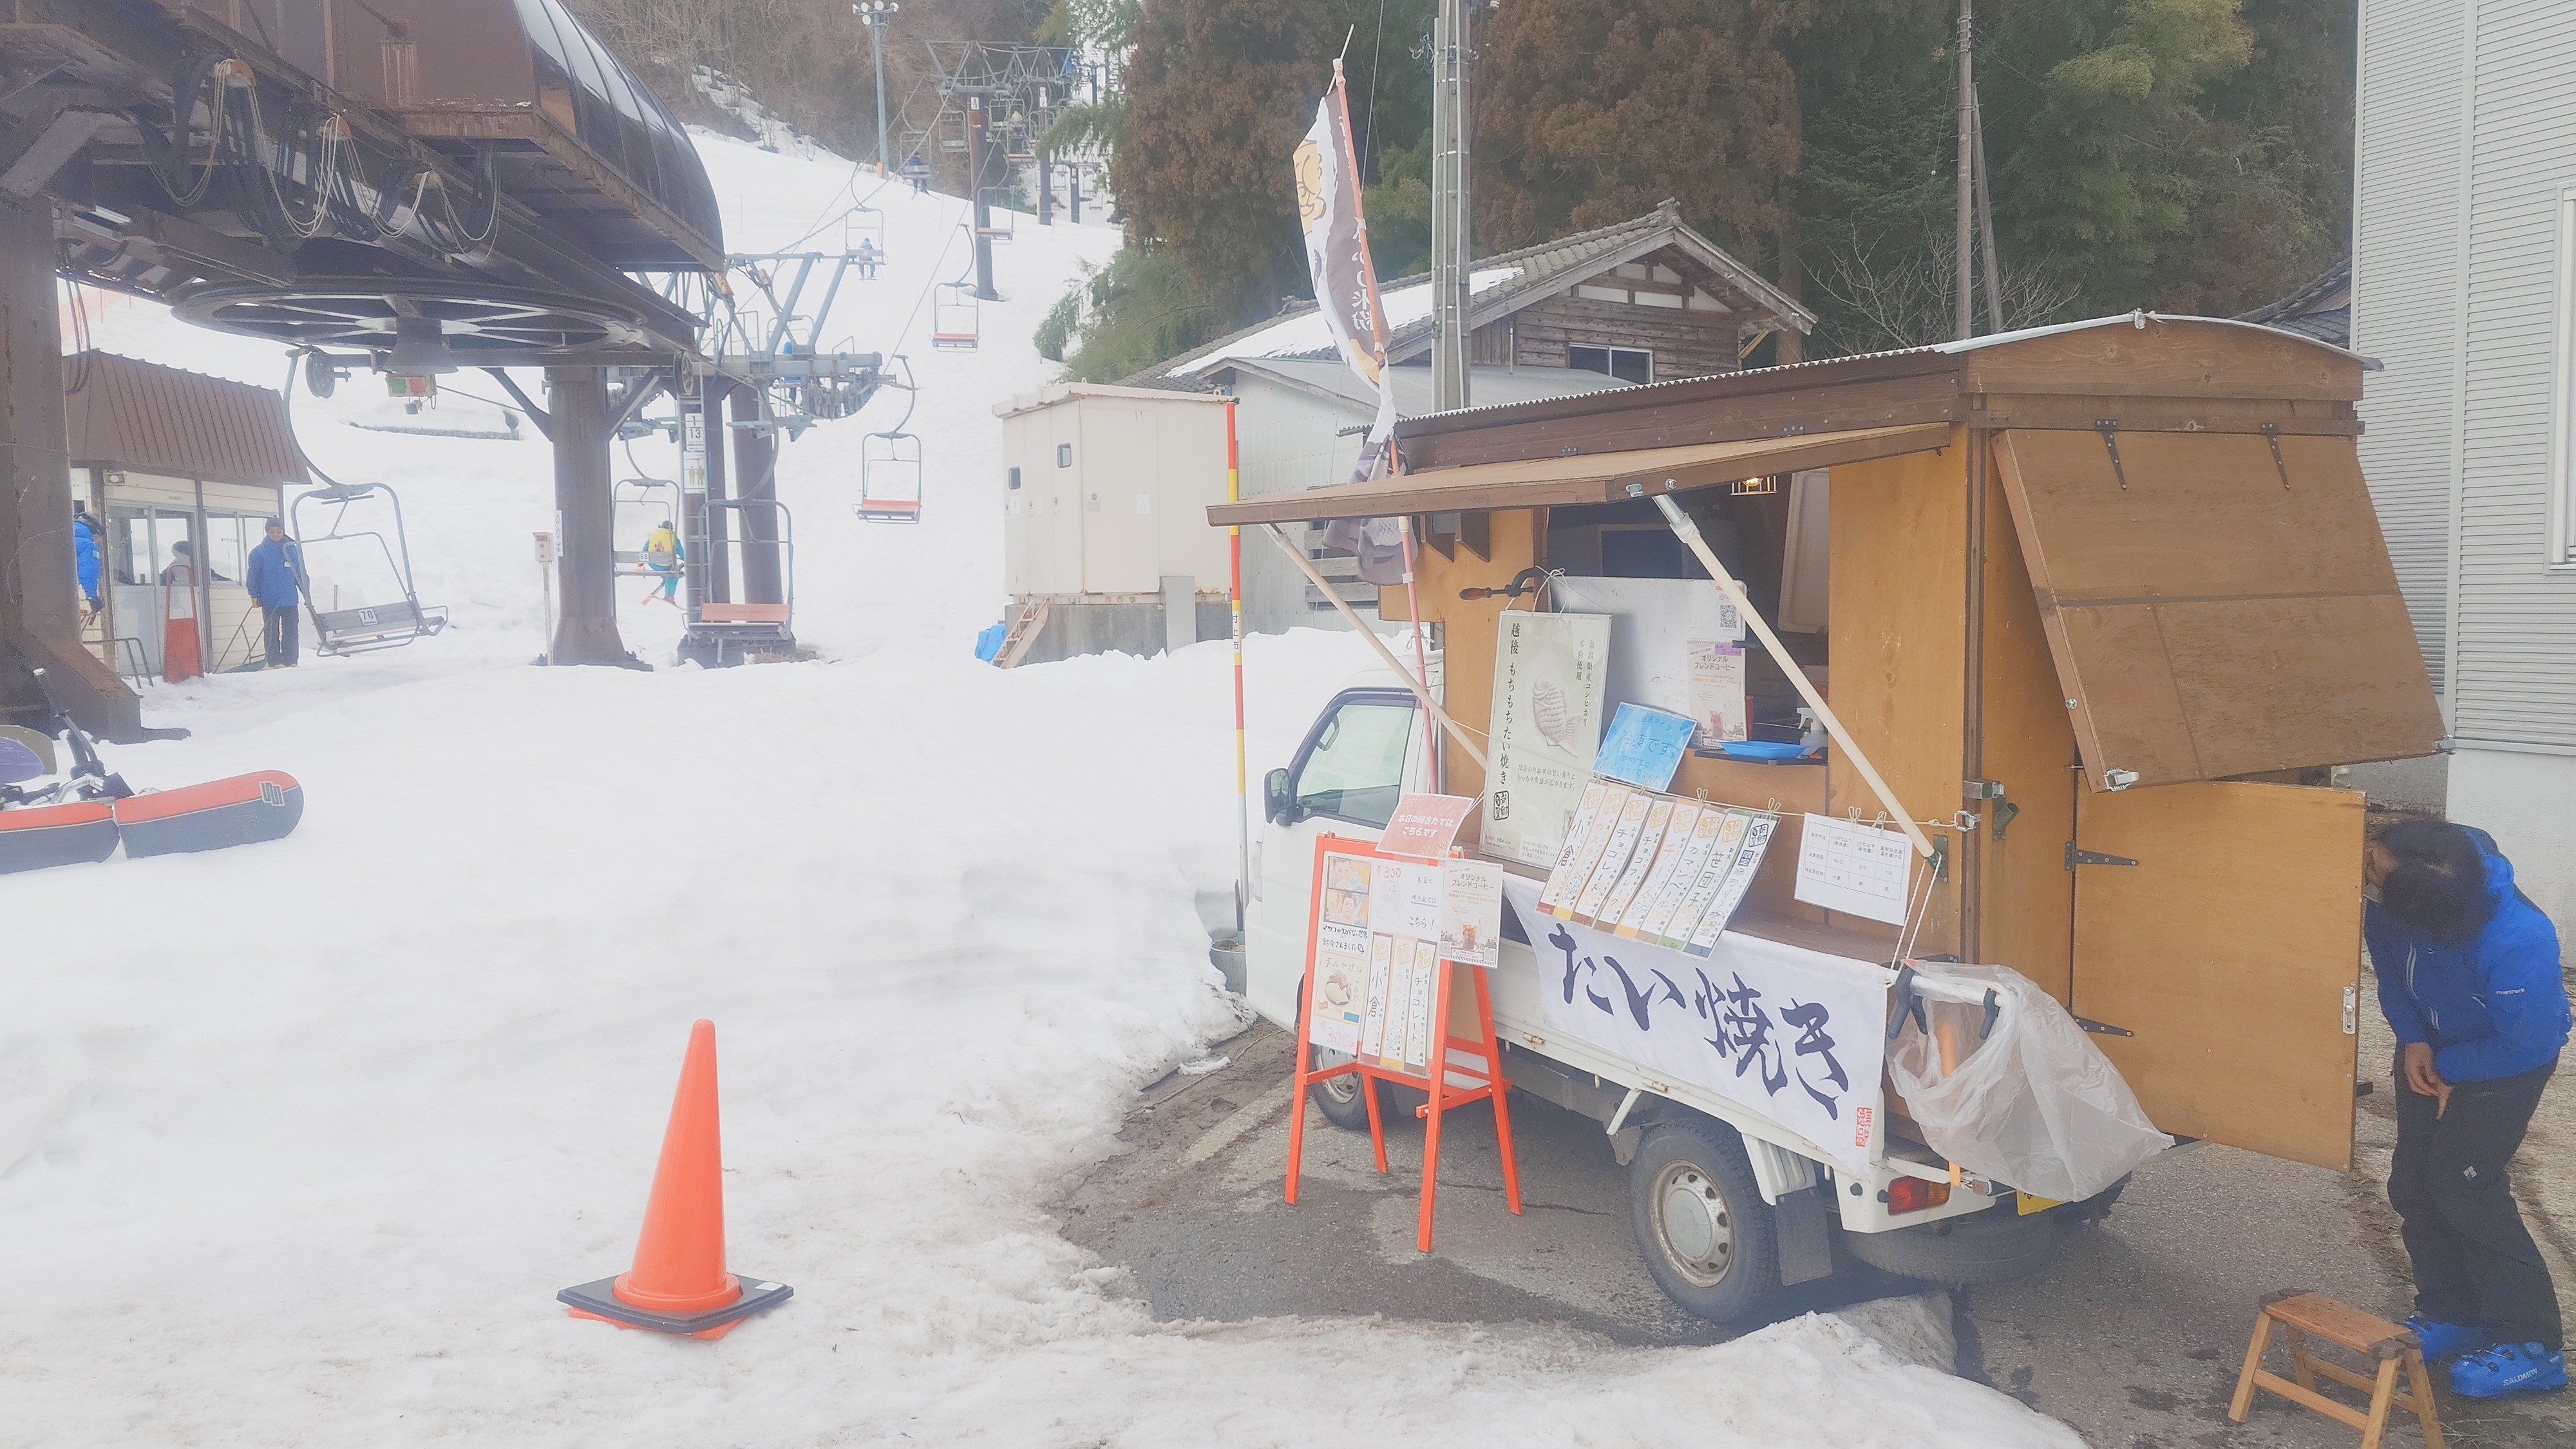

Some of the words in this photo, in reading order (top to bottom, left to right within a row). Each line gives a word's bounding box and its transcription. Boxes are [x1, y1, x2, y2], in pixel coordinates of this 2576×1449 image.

[692, 416, 696, 426] 1
[690, 428, 701, 439] 13
[361, 611, 374, 620] 70
[1510, 623, 1521, 655] 越後
[1576, 639, 1585, 681] 米粉使用
[1694, 662, 1736, 670] ブレンドコーヒー
[1500, 662, 1516, 784] もちもちたい焼き
[1518, 764, 1575, 780] ほんのりお米の甘い香りと
[1397, 814, 1454, 827] 本日の焼きたては
[1402, 826, 1437, 837] こちらです
[1591, 829, 1628, 891] チョコレート
[1417, 876, 1434, 884] 本日の
[1460, 873, 1487, 882] オリジナル
[1452, 880, 1494, 890] ブレンドコーヒー
[1368, 971, 1383, 1018] 小倉
[1412, 978, 1423, 1042] チョコレート
[1548, 923, 1849, 1121] たい焼き
[2503, 1367, 2539, 1387] SALOMON
